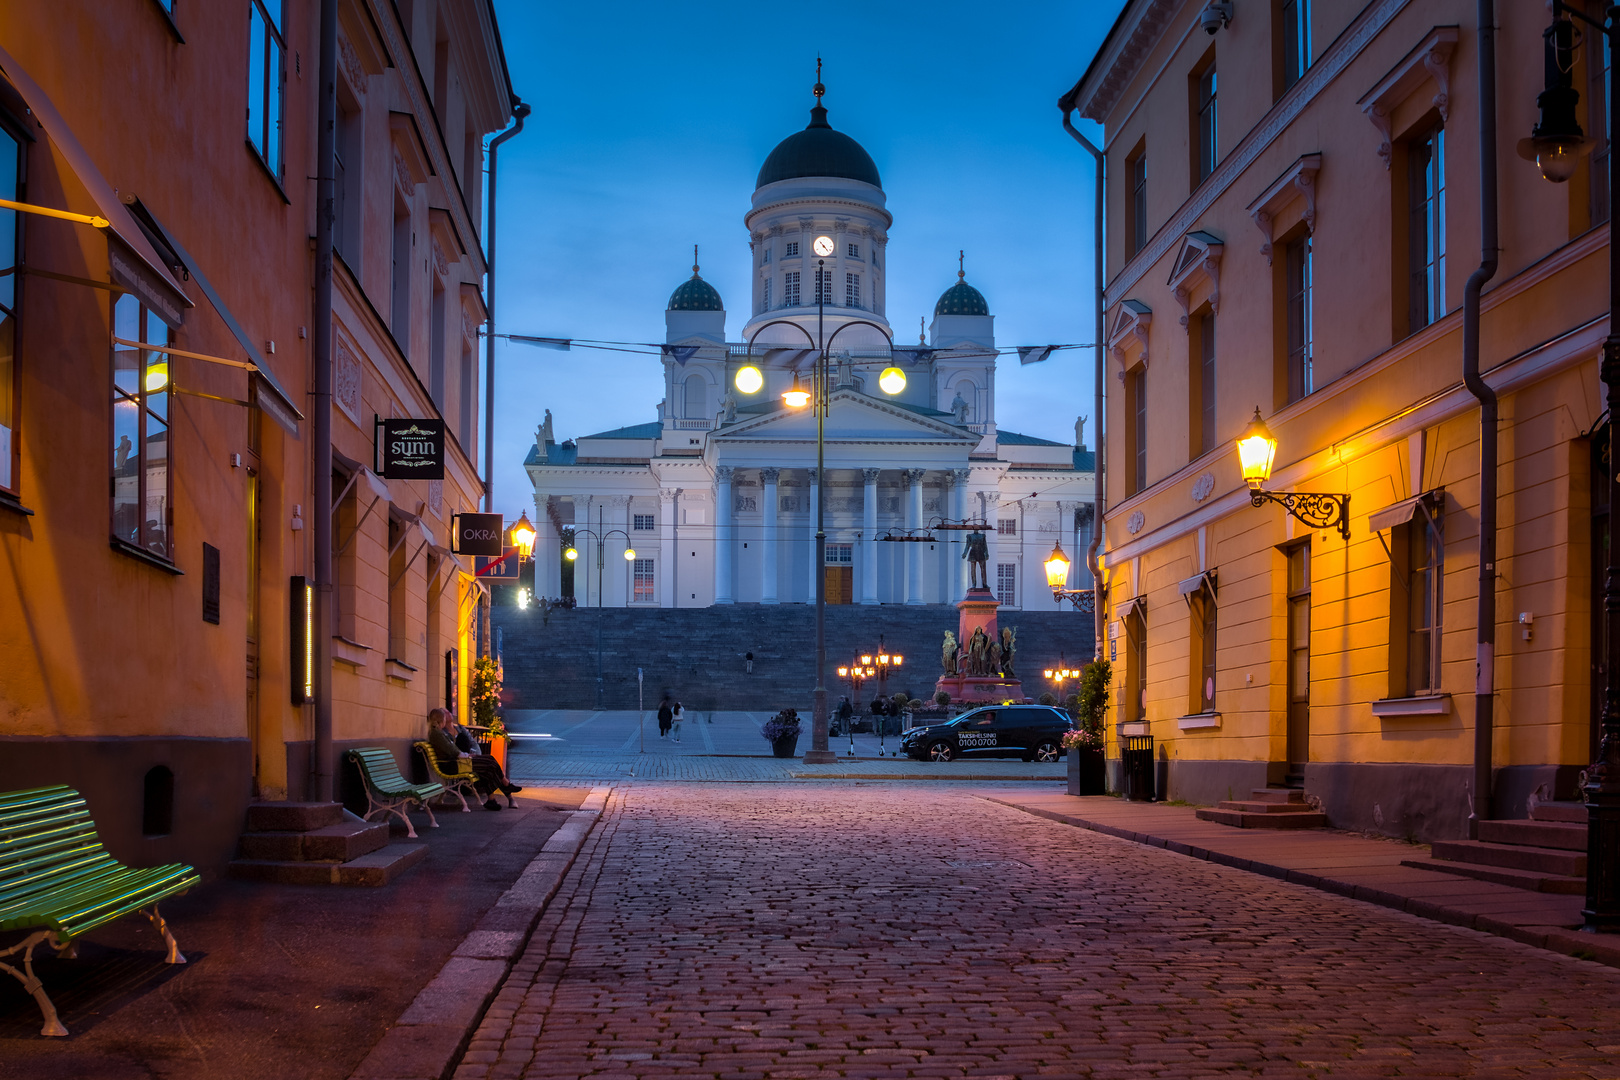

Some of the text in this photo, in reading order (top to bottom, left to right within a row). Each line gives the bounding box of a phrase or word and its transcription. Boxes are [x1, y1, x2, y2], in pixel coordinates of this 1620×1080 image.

[391, 441, 436, 456] sunn
[463, 528, 498, 540] OKRA
[958, 738, 997, 746] 0100 0700
